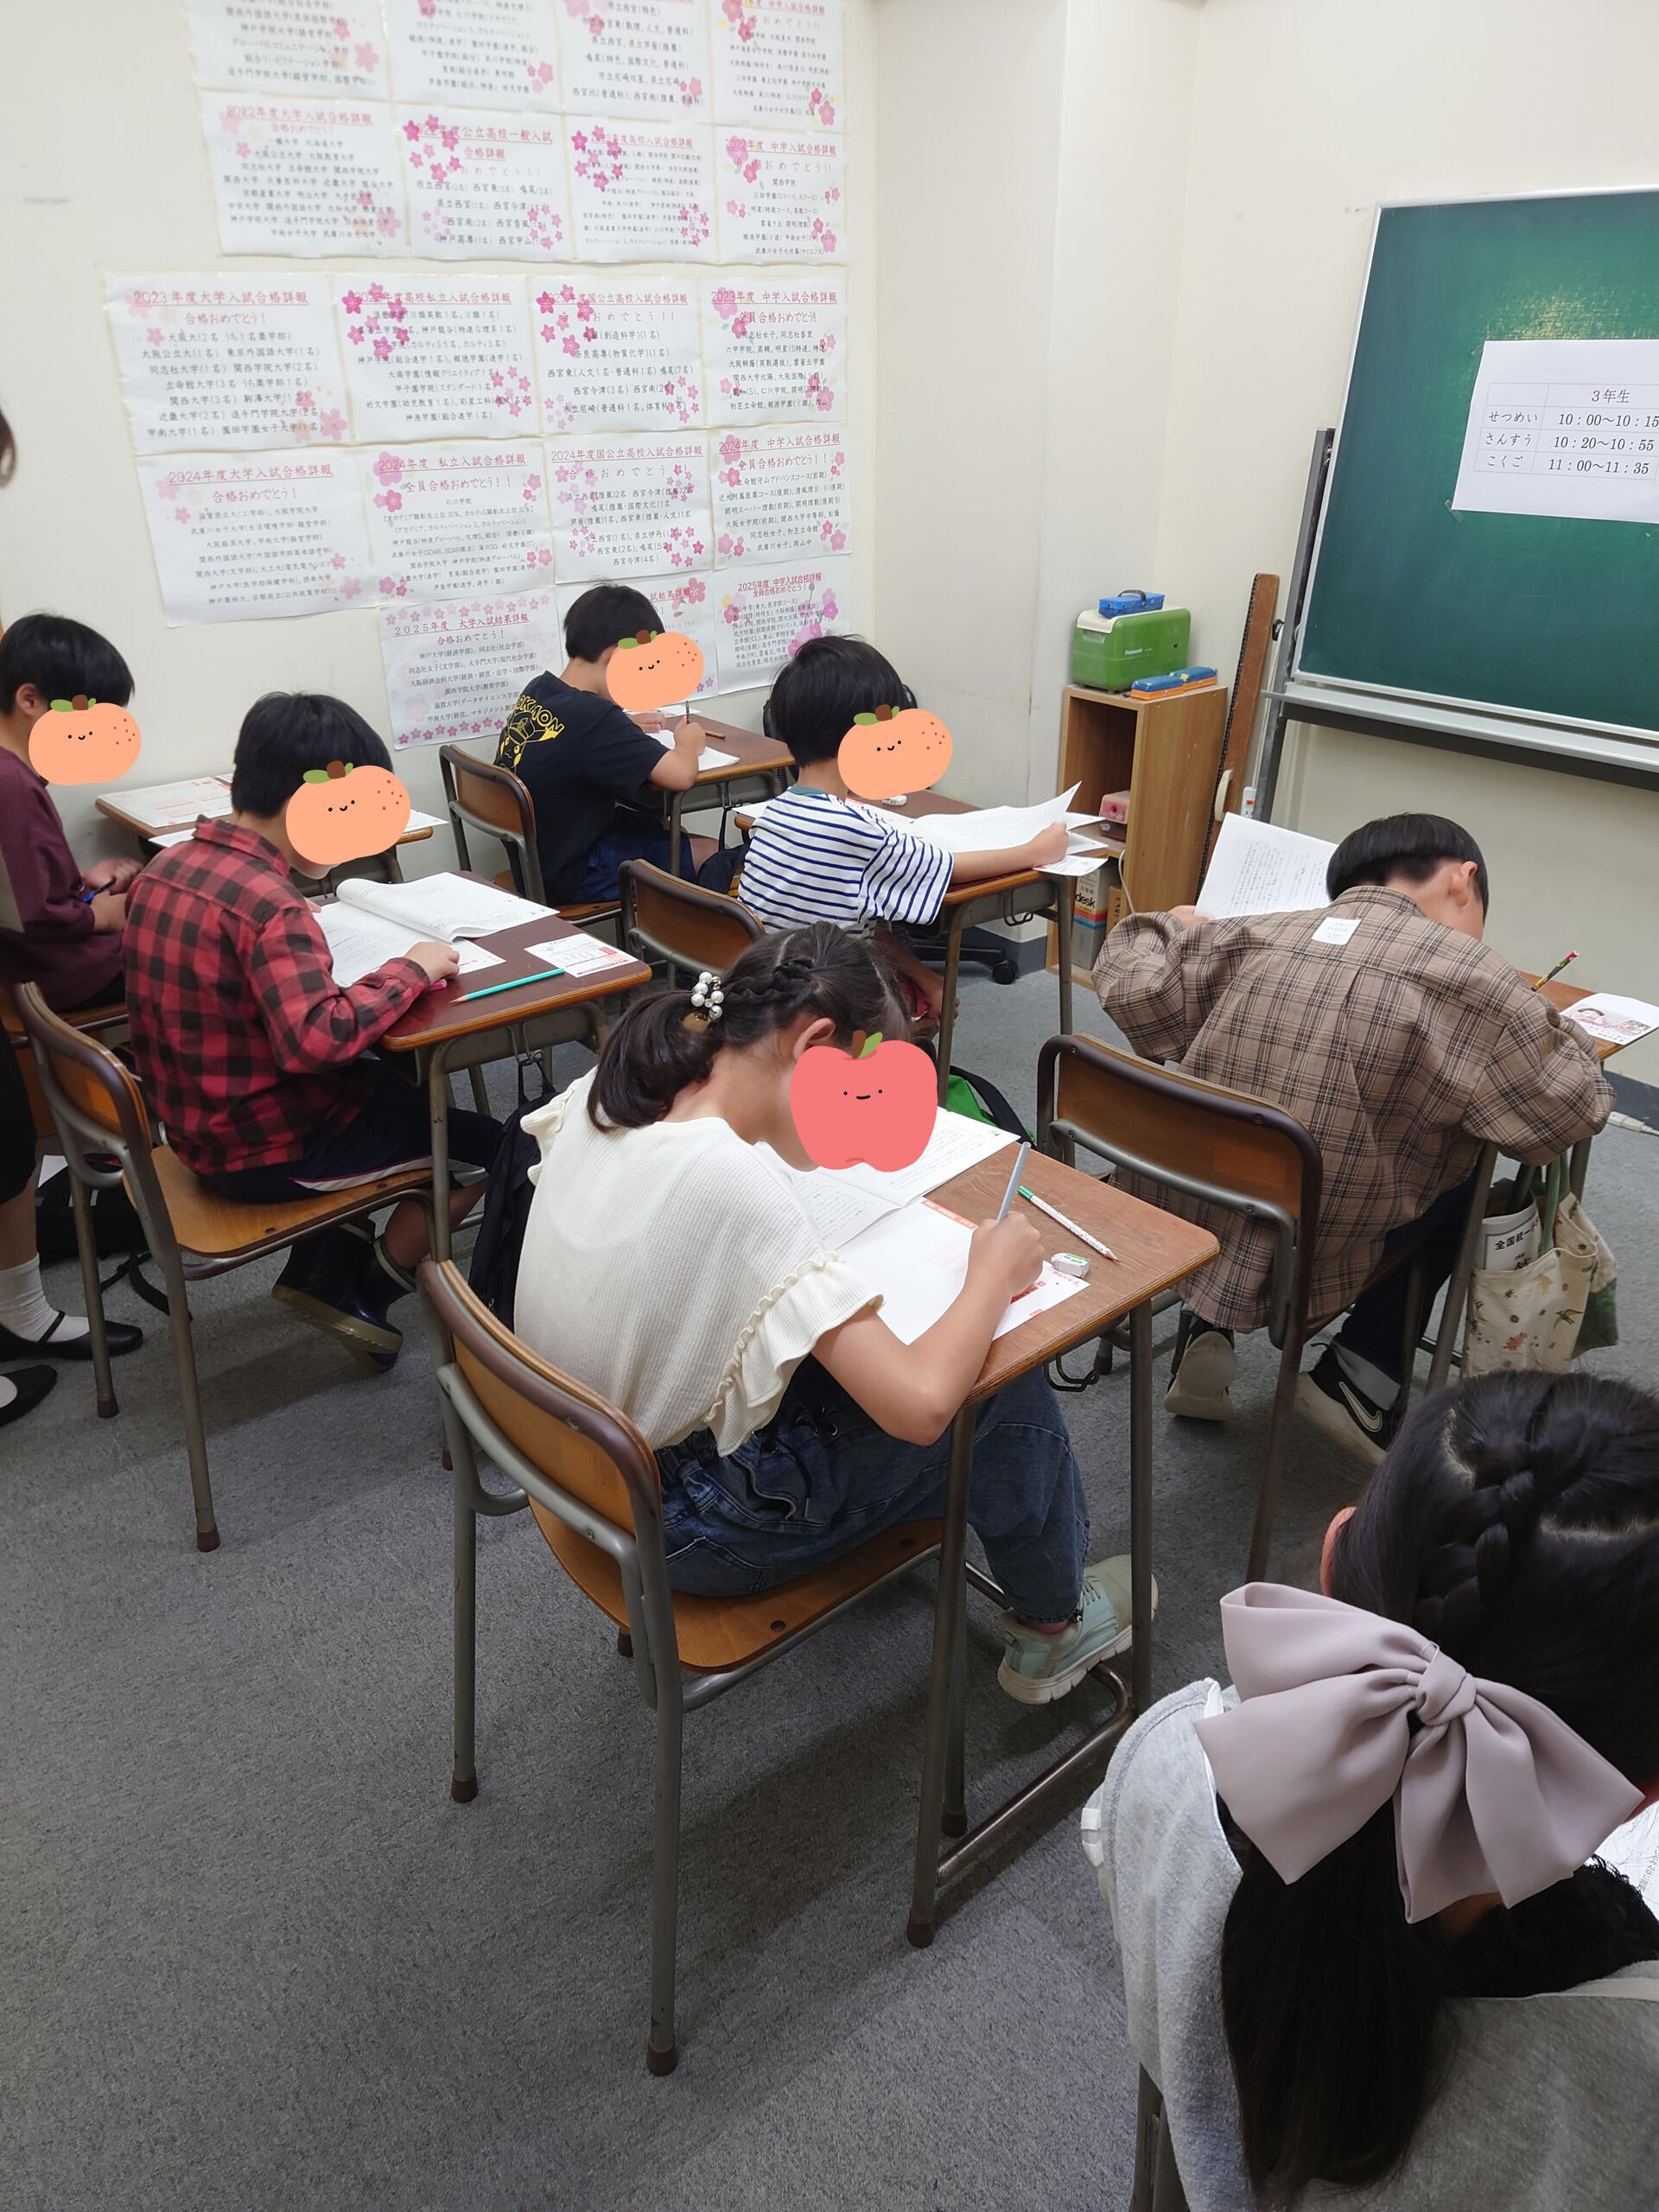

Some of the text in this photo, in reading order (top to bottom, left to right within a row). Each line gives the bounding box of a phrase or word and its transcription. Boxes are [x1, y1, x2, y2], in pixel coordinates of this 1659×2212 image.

[464, 147, 505, 159] 合格詳報
[771, 141, 837, 157] 中学入試合格詳報
[711, 290, 837, 303] 2023年度 中学入試合格詳報
[1591, 388, 1631, 404] 3年生
[1488, 410, 1539, 423] せつめい
[718, 433, 841, 452] 2024年度 中学入試合格詳報
[1484, 432, 1533, 448] さんすう
[551, 445, 704, 462] 2024年度国公立高校入試合格詳報
[1486, 454, 1524, 468] こくご
[378, 453, 527, 473] 2024年度 私立入試合格詳報
[169, 464, 334, 485] 2024年度大学入試合格詳報
[737, 571, 822, 593] 2025年度 中学入試合格詳報
[394, 613, 530, 636] 2025年度 大学入試結果詳報
[1075, 893, 1096, 909] desk
